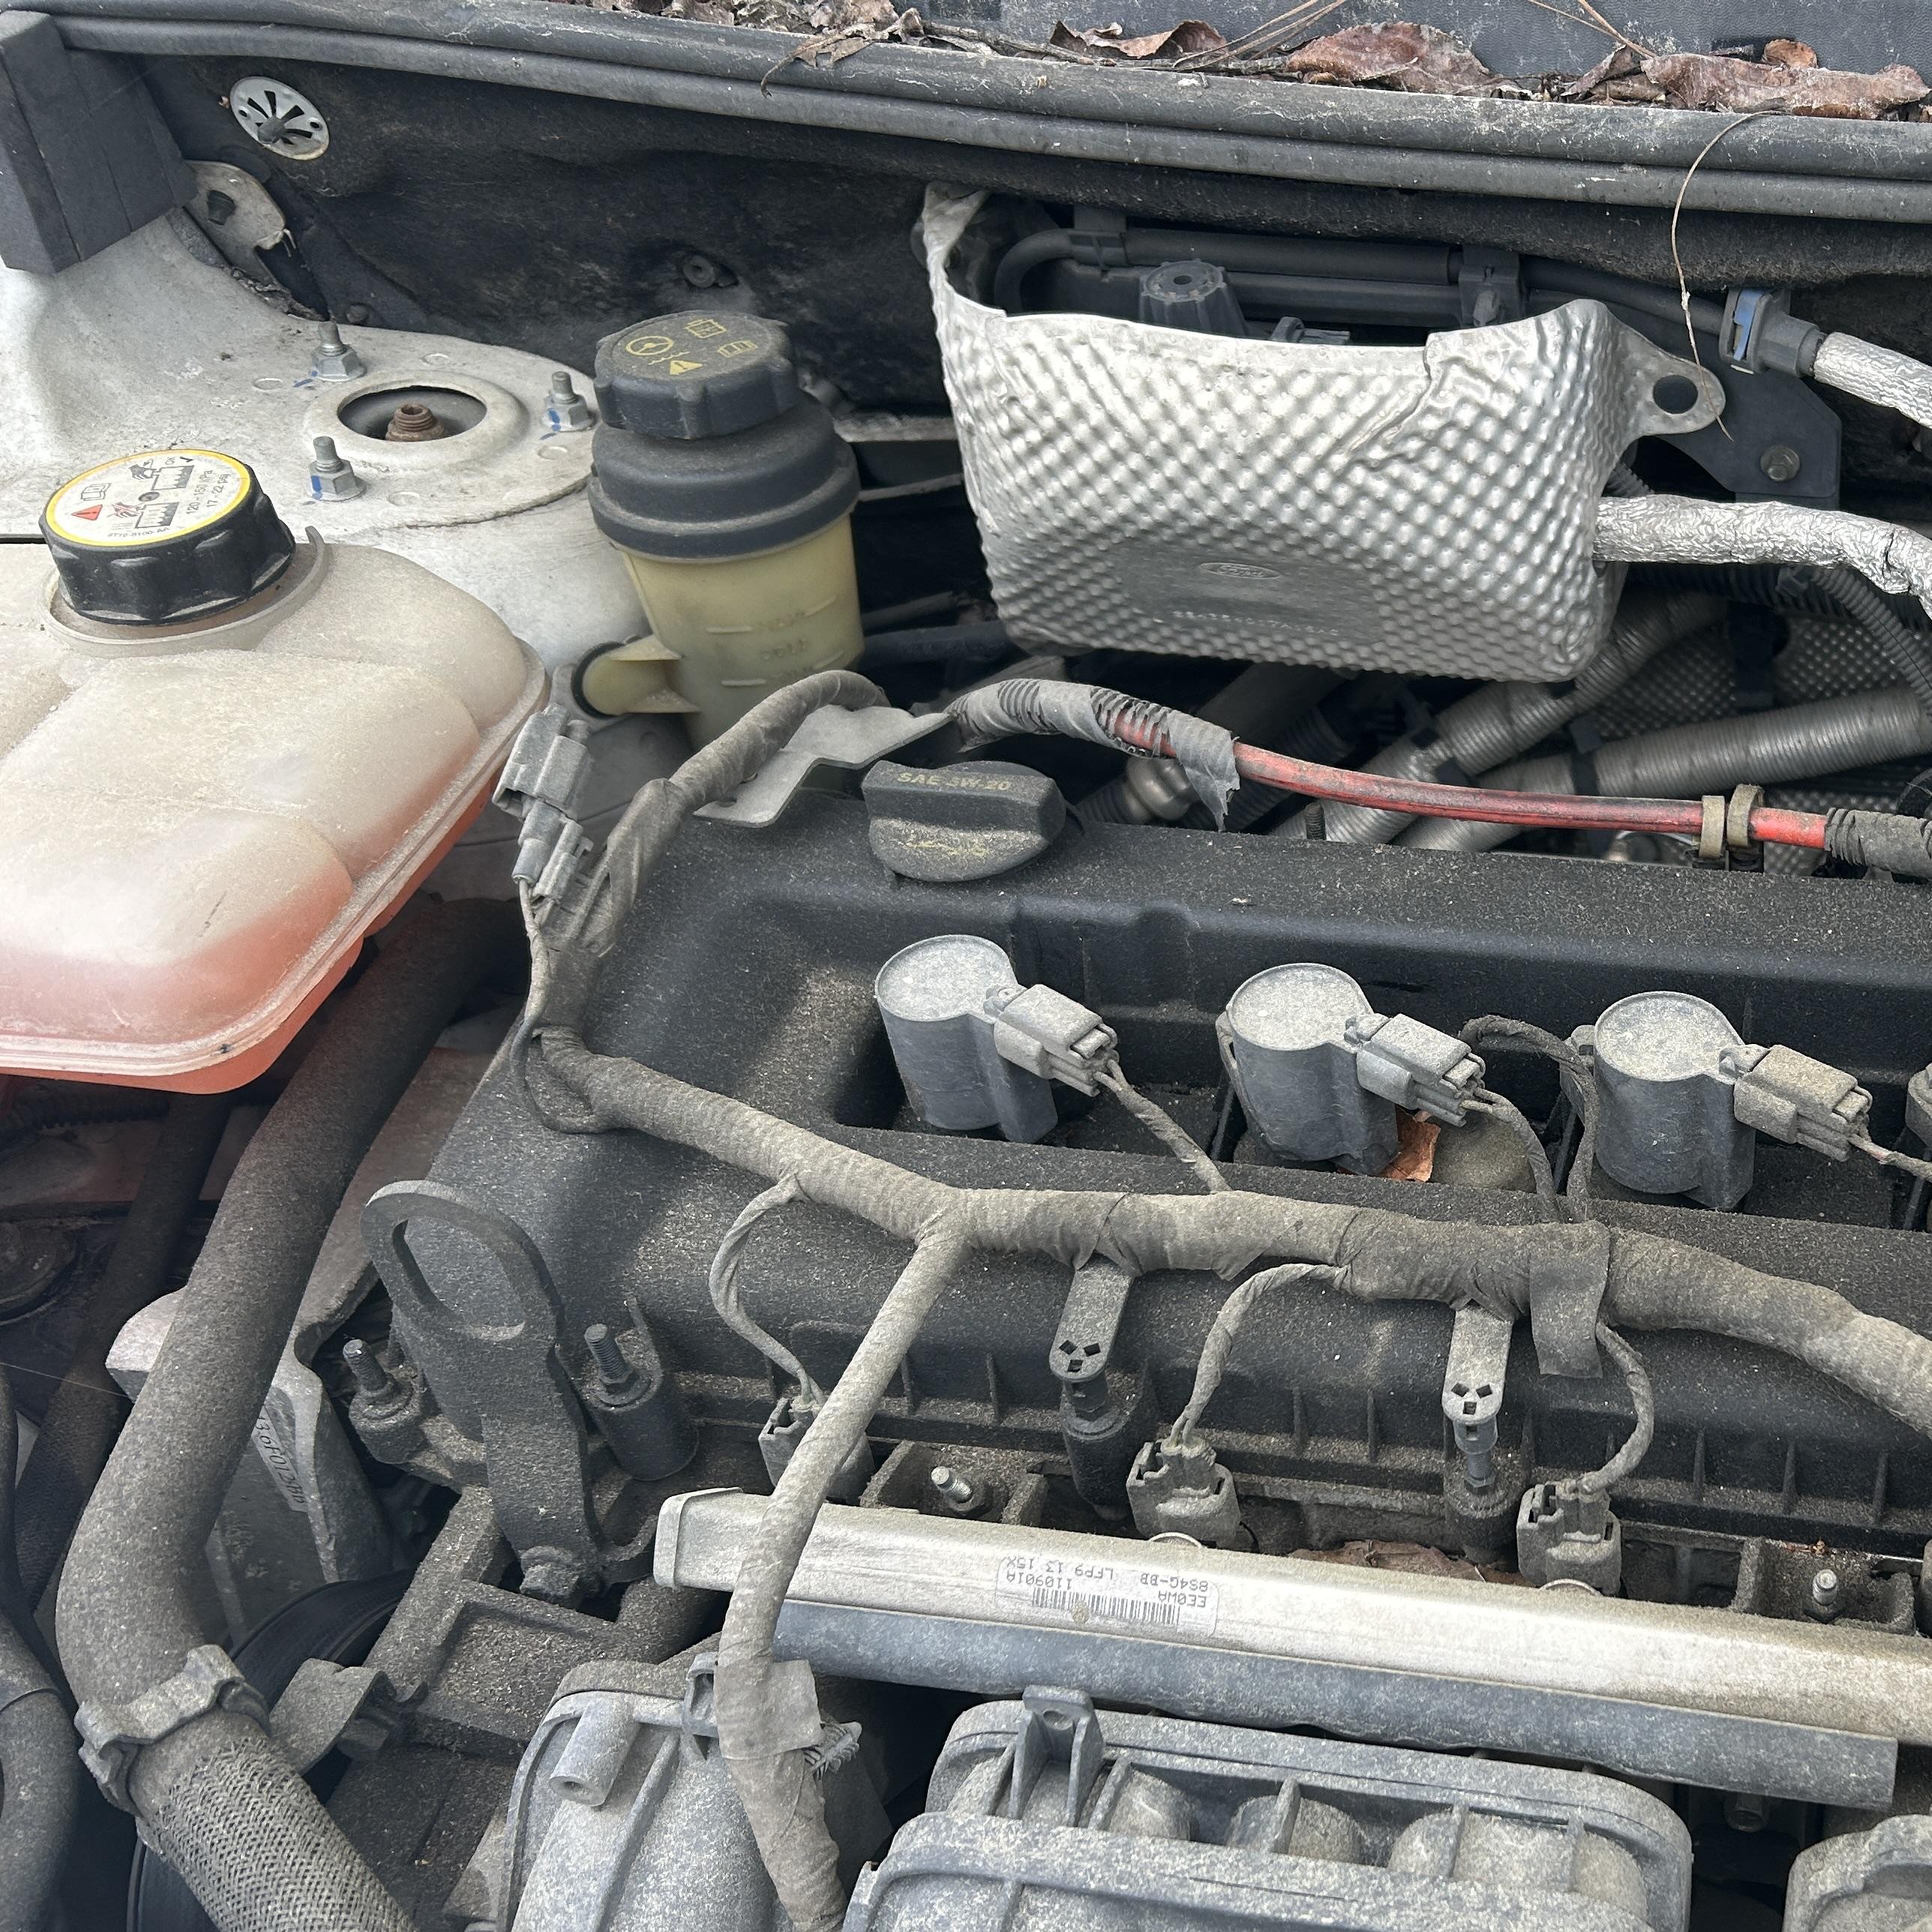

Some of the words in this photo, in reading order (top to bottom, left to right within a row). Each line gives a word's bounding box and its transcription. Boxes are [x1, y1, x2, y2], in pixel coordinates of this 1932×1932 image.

[211, 485, 224, 494] 22
[185, 502, 200, 514] 120
[206, 500, 218, 508] 17
[898, 772, 940, 785] SAE
[946, 776, 1012, 791] 5W-20
[1006, 1556, 1034, 1570] 15X
[1046, 1561, 1064, 1574] 13
[1075, 1564, 1114, 1580] LFP9
[1006, 1570, 1072, 1590] 110901A
[1140, 1572, 1208, 1592] 8S4G-BB
